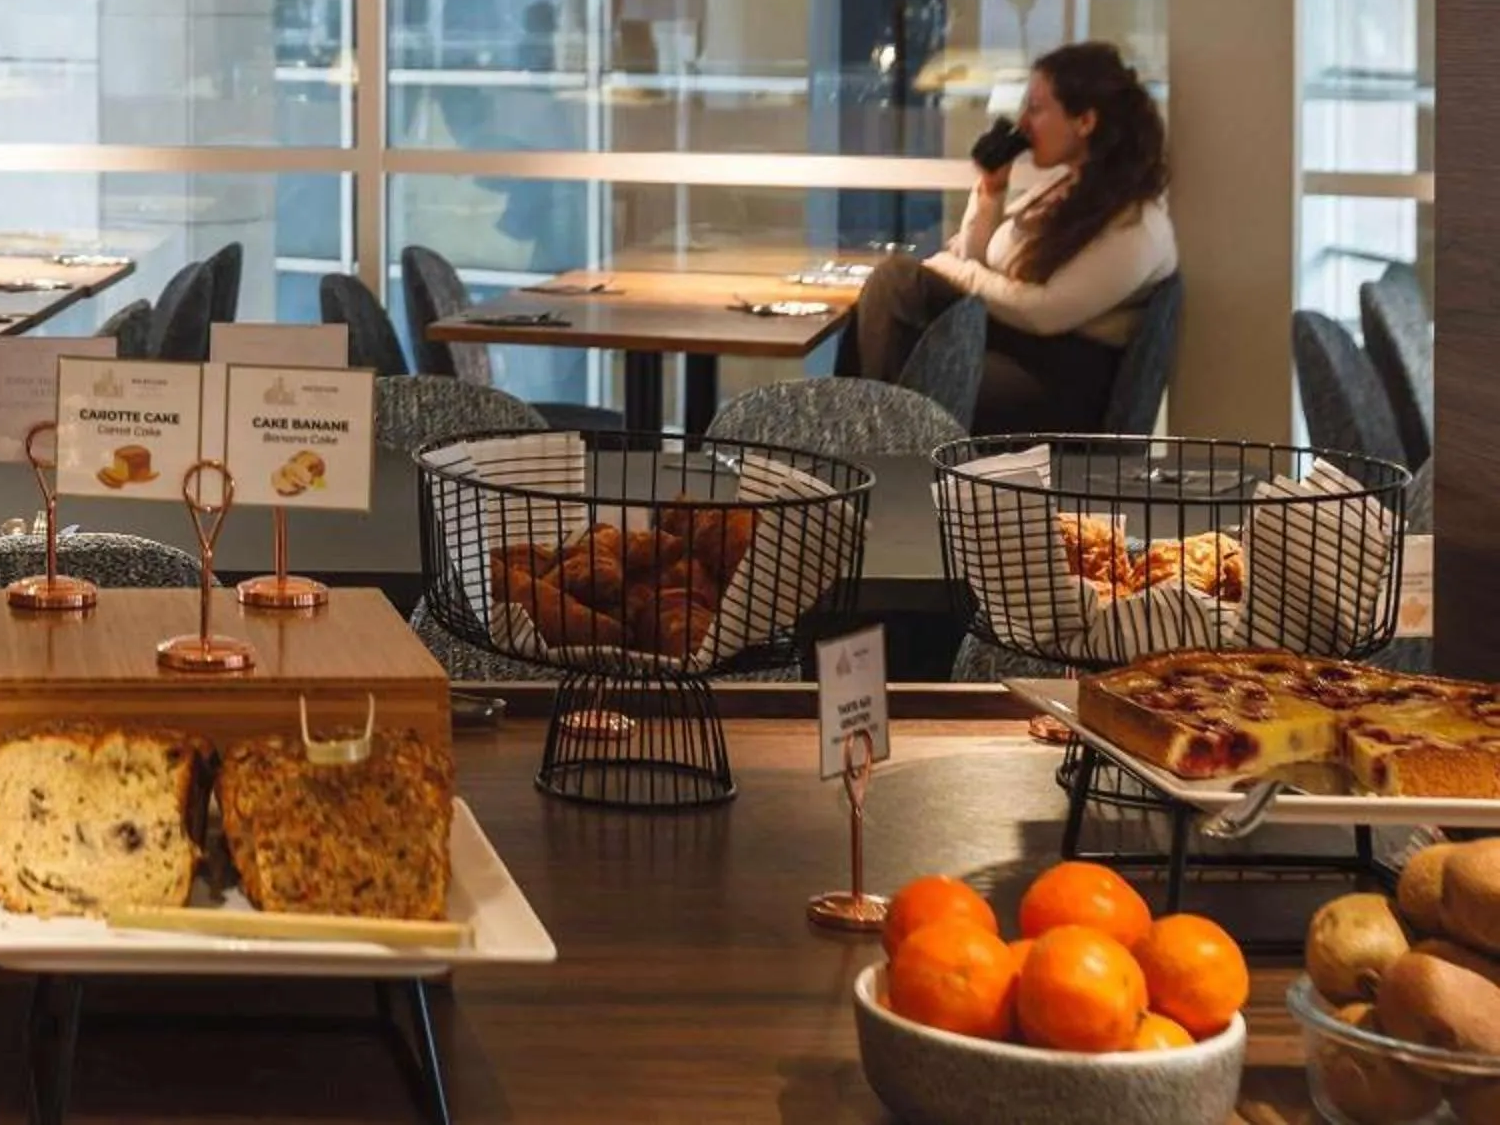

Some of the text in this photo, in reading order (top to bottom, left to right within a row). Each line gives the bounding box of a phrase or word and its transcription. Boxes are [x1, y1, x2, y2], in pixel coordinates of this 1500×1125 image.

[79, 408, 180, 424] CAROTTE CAKE
[252, 417, 349, 432] CAKE BANANE
